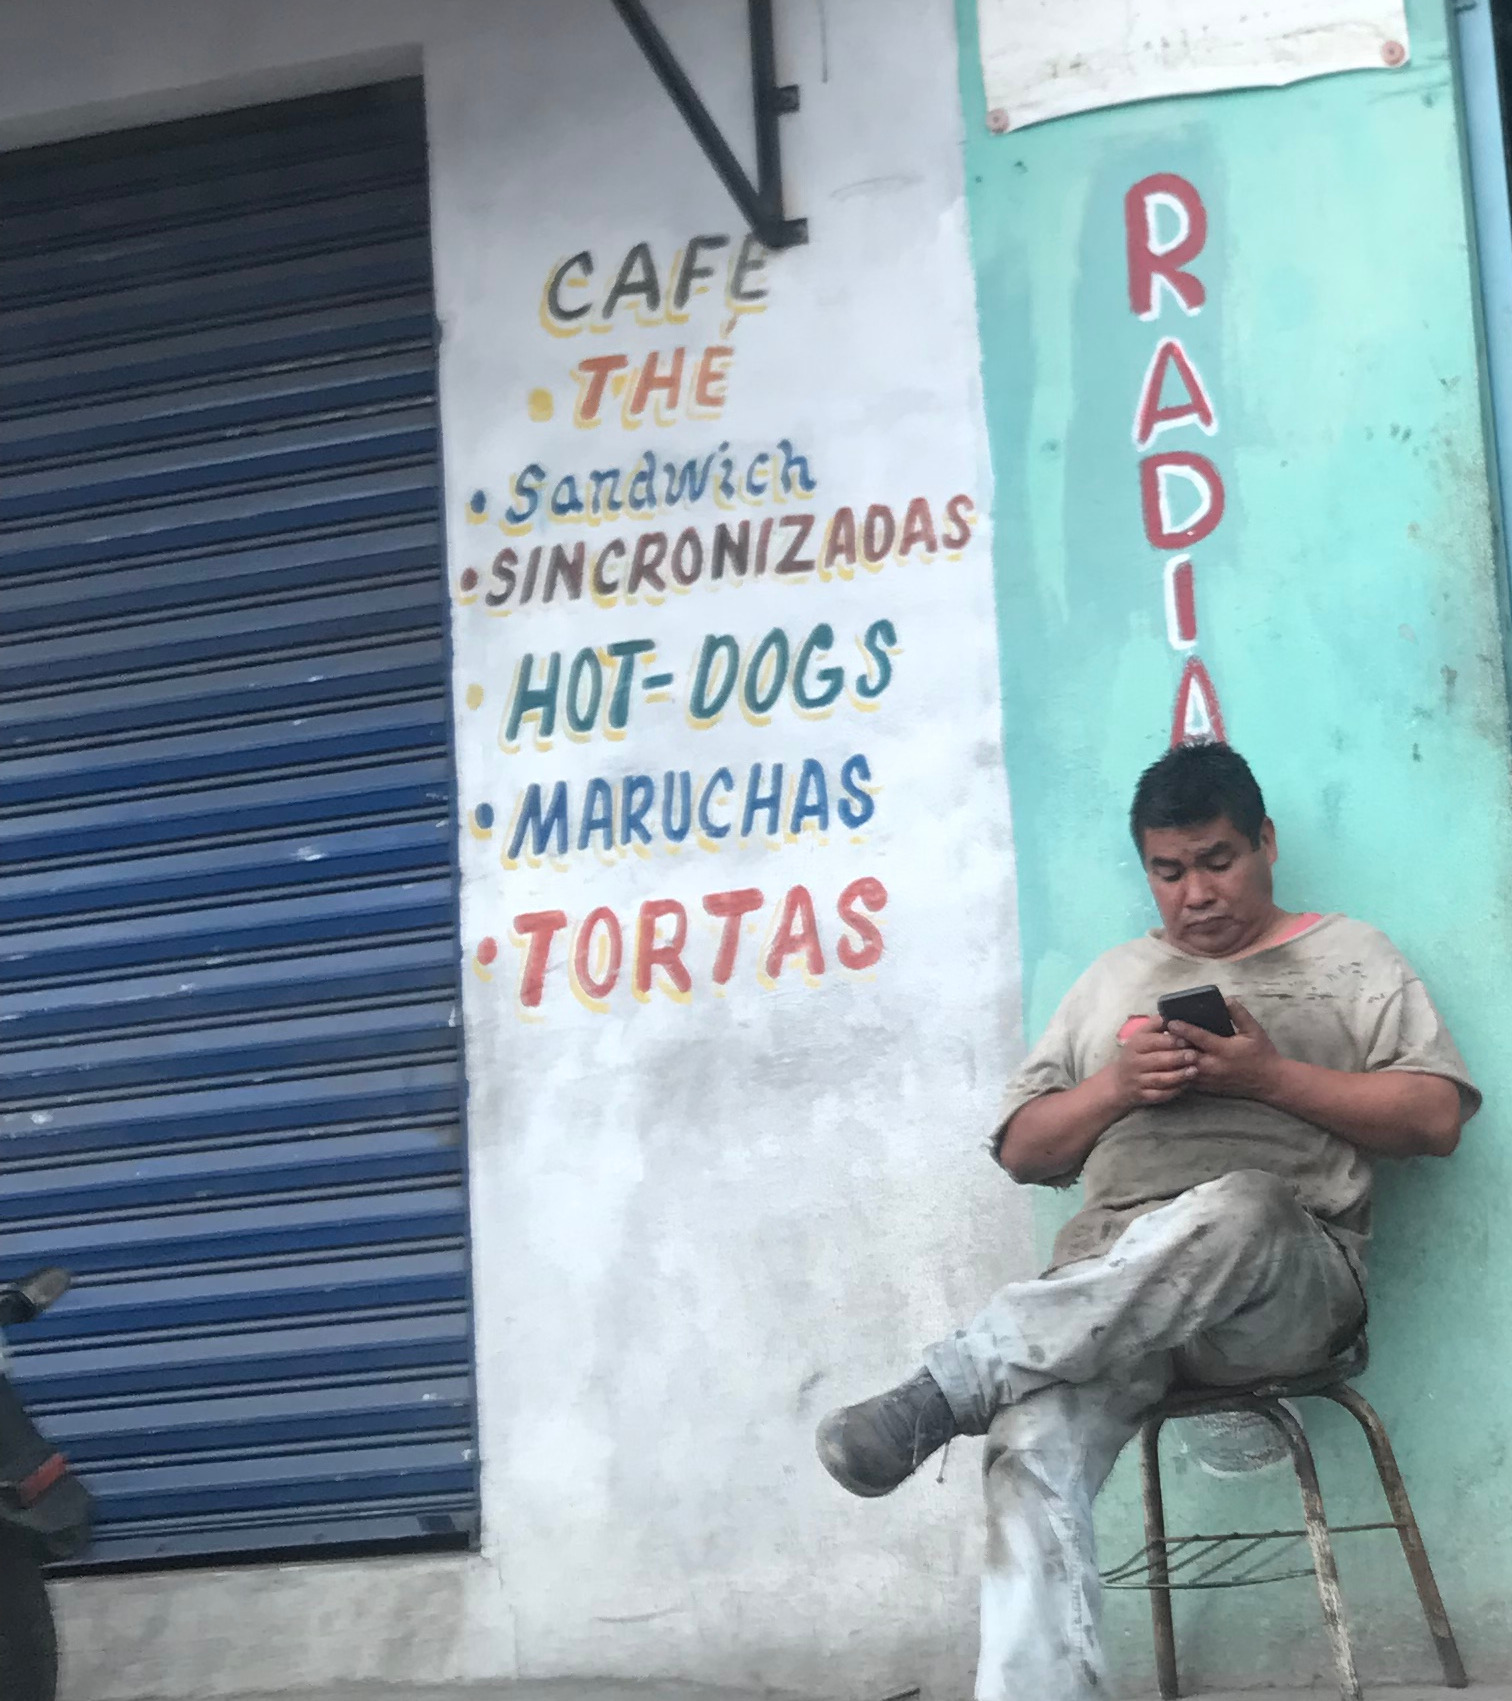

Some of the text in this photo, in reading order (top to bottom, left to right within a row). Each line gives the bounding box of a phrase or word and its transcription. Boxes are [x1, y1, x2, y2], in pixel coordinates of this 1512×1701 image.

[503, 438, 818, 532] Sandwich
[484, 494, 976, 612] SINCRONIZADAS
[505, 753, 878, 866] MARUCHAS
[512, 876, 890, 1014] TORTAS
